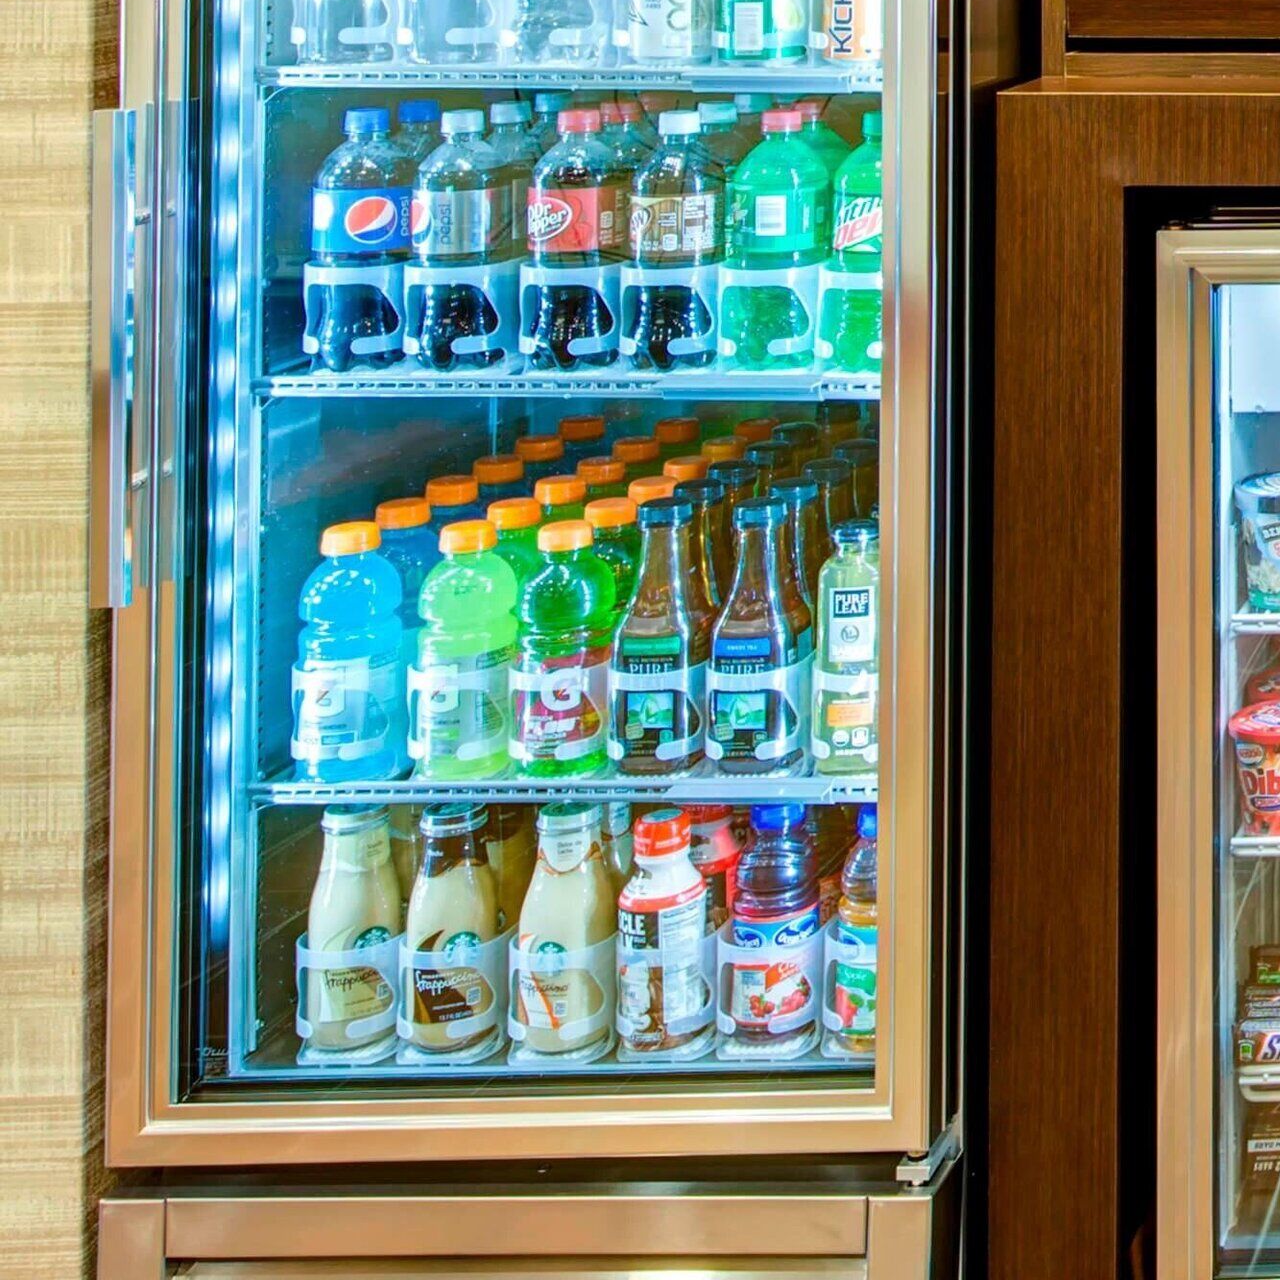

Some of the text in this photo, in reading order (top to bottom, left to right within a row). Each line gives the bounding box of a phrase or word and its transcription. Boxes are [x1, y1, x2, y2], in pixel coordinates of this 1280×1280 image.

[401, 195, 411, 238] pepsi
[835, 592, 870, 605] PURE
[835, 601, 867, 614] LEAF
